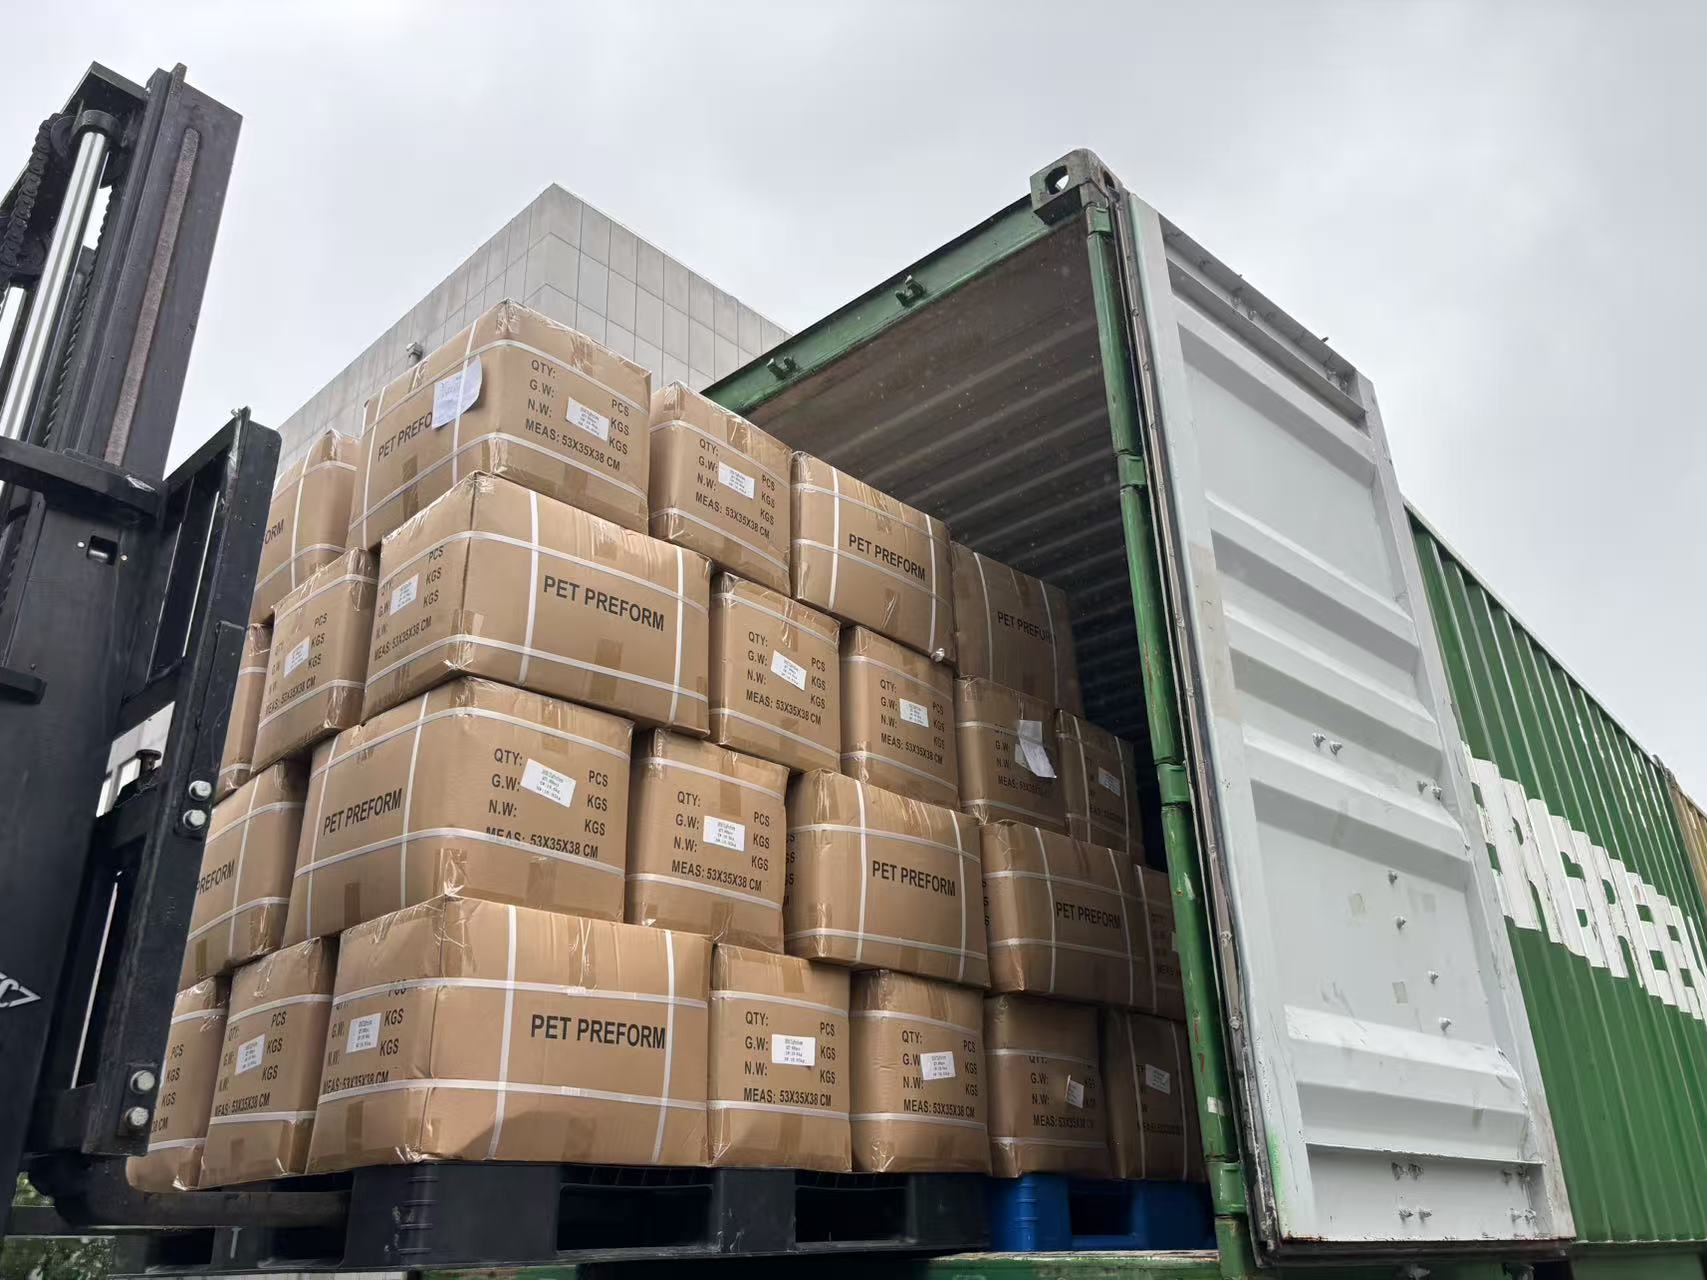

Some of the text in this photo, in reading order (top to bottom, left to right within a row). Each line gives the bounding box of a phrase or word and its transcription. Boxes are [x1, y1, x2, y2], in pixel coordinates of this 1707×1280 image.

[531, 359, 630, 417] QTY: PCS
[529, 379, 555, 398] G.W:
[611, 417, 630, 435] KGS
[378, 411, 433, 462] PET PREFO
[527, 399, 628, 455] N.W: KGS
[525, 419, 560, 443] MEAS:
[562, 435, 605, 464] 53X35X38
[607, 455, 621, 471] CM
[699, 438, 719, 456] QTY:
[762, 474, 775, 491] PCS
[697, 472, 716, 491] N.W:
[760, 508, 775, 525] KGS
[761, 492, 776, 508] KGS
[695, 491, 770, 540] MEAS: 53X35X38 CM
[848, 533, 925, 581] PET PREFORM
[426, 567, 441, 585] KGS
[423, 590, 439, 608] KGS
[544, 574, 664, 631] PET PREFORM
[421, 616, 432, 631] CM
[997, 611, 1015, 628] PET
[748, 632, 825, 672] QTY: PCS
[747, 651, 826, 690] G.W: KGS
[747, 670, 766, 685] N.W:
[810, 694, 826, 709] KGS
[880, 679, 897, 693] QTY:
[932, 701, 944, 715] PCS
[746, 689, 821, 725] MEAS: 53X35X38 CM
[881, 715, 897, 729] N.W:
[933, 718, 944, 733] KGS
[881, 733, 903, 749] MEAS:
[494, 748, 608, 787] QTY: PCS
[491, 773, 521, 792] G.W:
[587, 795, 608, 812] KGS
[323, 788, 402, 836] PET PREFORM
[488, 799, 605, 836] N.W: KGS
[677, 791, 770, 827] QTY: PCS
[675, 813, 699, 830] G.W:
[753, 834, 769, 849] KGS
[530, 834, 580, 855] 53X35X38
[583, 842, 598, 859] CM
[673, 836, 697, 853] N.W:
[751, 856, 769, 871] KGS
[672, 860, 762, 892] MEAS: 53X35X38 CM
[872, 861, 955, 897] PET PREFORM
[1056, 901, 1121, 929] PET PREFORM
[271, 1011, 286, 1027] PCS
[384, 1008, 404, 1027] KGS
[745, 1012, 835, 1037] QTY: PCS
[531, 1014, 666, 1049] PET PREFORM
[902, 1031, 975, 1052] QTY: PCS
[267, 1038, 283, 1053] KGS
[380, 1038, 399, 1057] KGS
[745, 1037, 768, 1051] G.W:
[820, 1046, 836, 1060] KGS
[167, 1067, 180, 1081] KGS
[262, 1065, 278, 1081] KGS
[375, 1070, 389, 1083] CM
[744, 1062, 835, 1085] N.W: KGS
[902, 1054, 920, 1066] G.W
[965, 1062, 977, 1075] KGS
[903, 1077, 978, 1097] N.W: KGS
[1031, 1072, 1049, 1084] G.W:
[162, 1092, 176, 1106] KGS
[259, 1092, 270, 1107] CM
[744, 1088, 831, 1107] MEAS: 53X35X38 CM
[903, 1099, 975, 1118] MEAS: 53X35X38 CM
[1032, 1093, 1050, 1105] N.W:
[1033, 1113, 1058, 1128] MEAS:
